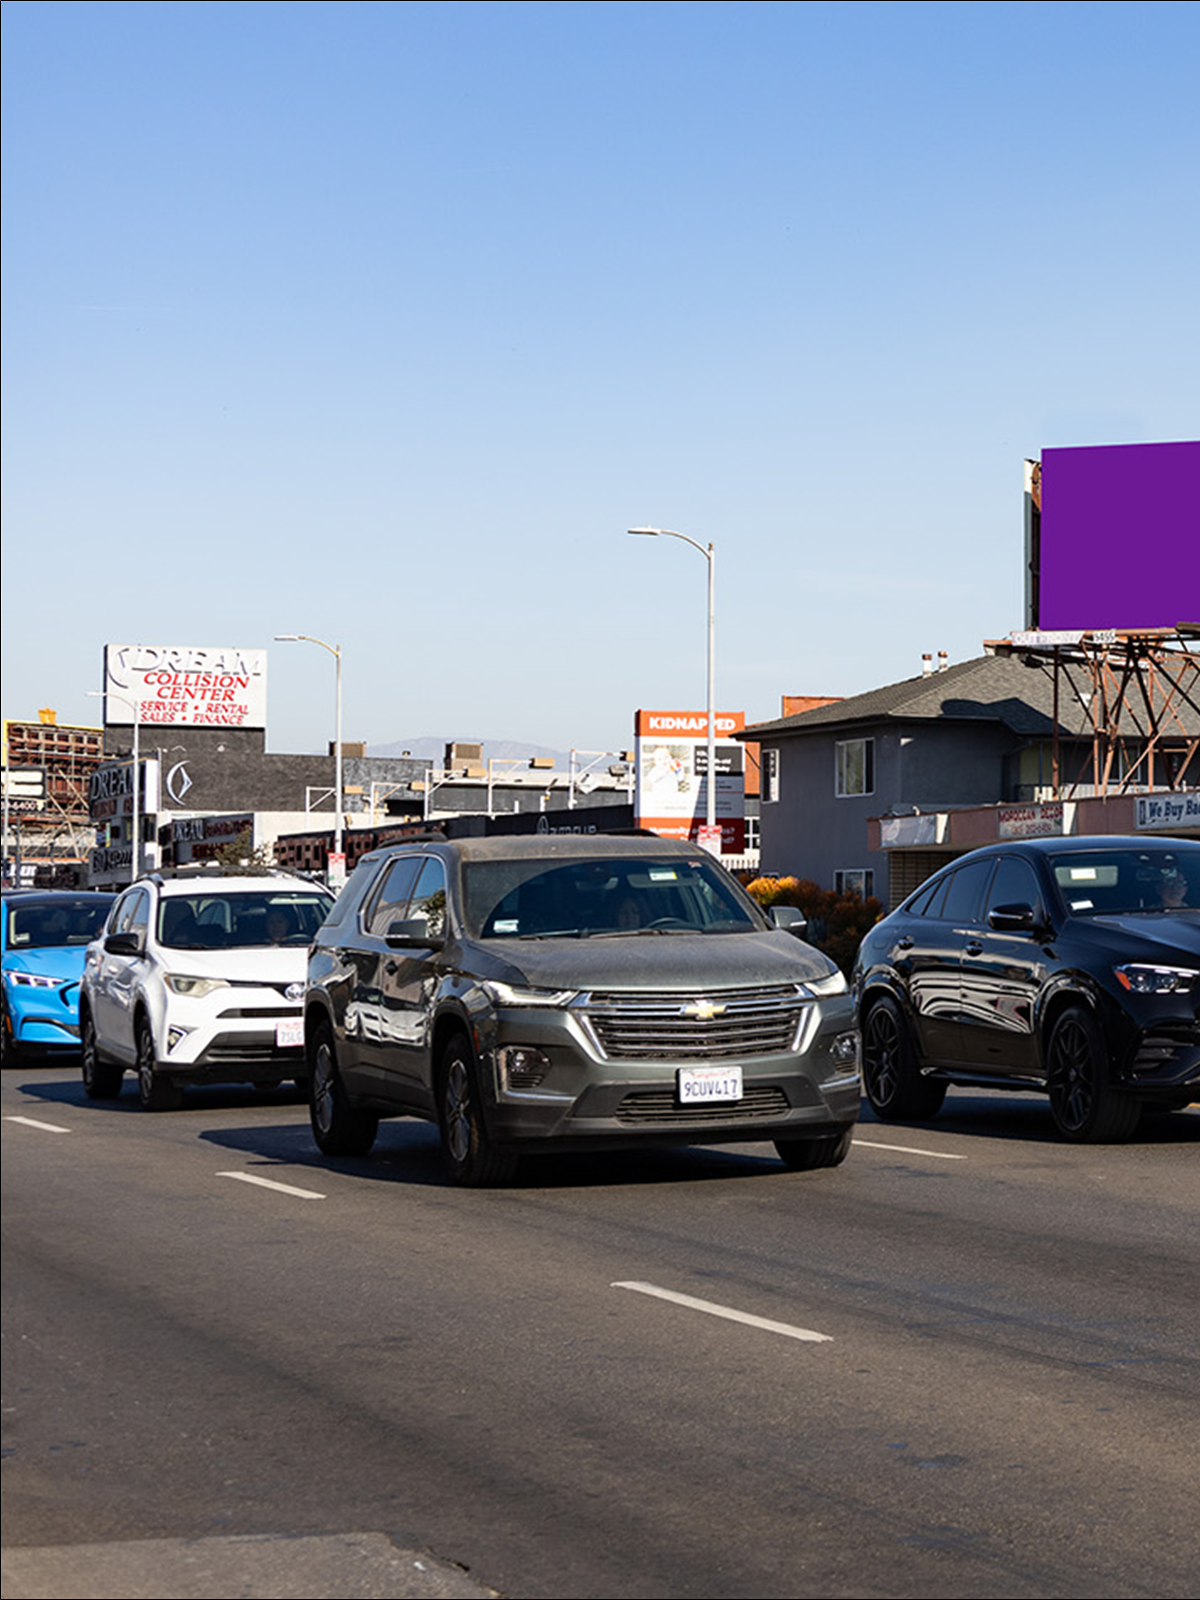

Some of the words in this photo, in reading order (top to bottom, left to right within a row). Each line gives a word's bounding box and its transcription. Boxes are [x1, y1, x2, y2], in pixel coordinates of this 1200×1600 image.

[143, 672, 250, 688] COLLISION
[157, 686, 235, 701] CENTER
[140, 701, 188, 712] SERVICE
[205, 703, 249, 714] RENTAL
[140, 712, 176, 722] SALES
[193, 713, 244, 725] FINANCE
[1149, 802, 1162, 817] We
[1164, 801, 1184, 821] Buy
[684, 1079, 738, 1097] 9CUV417
